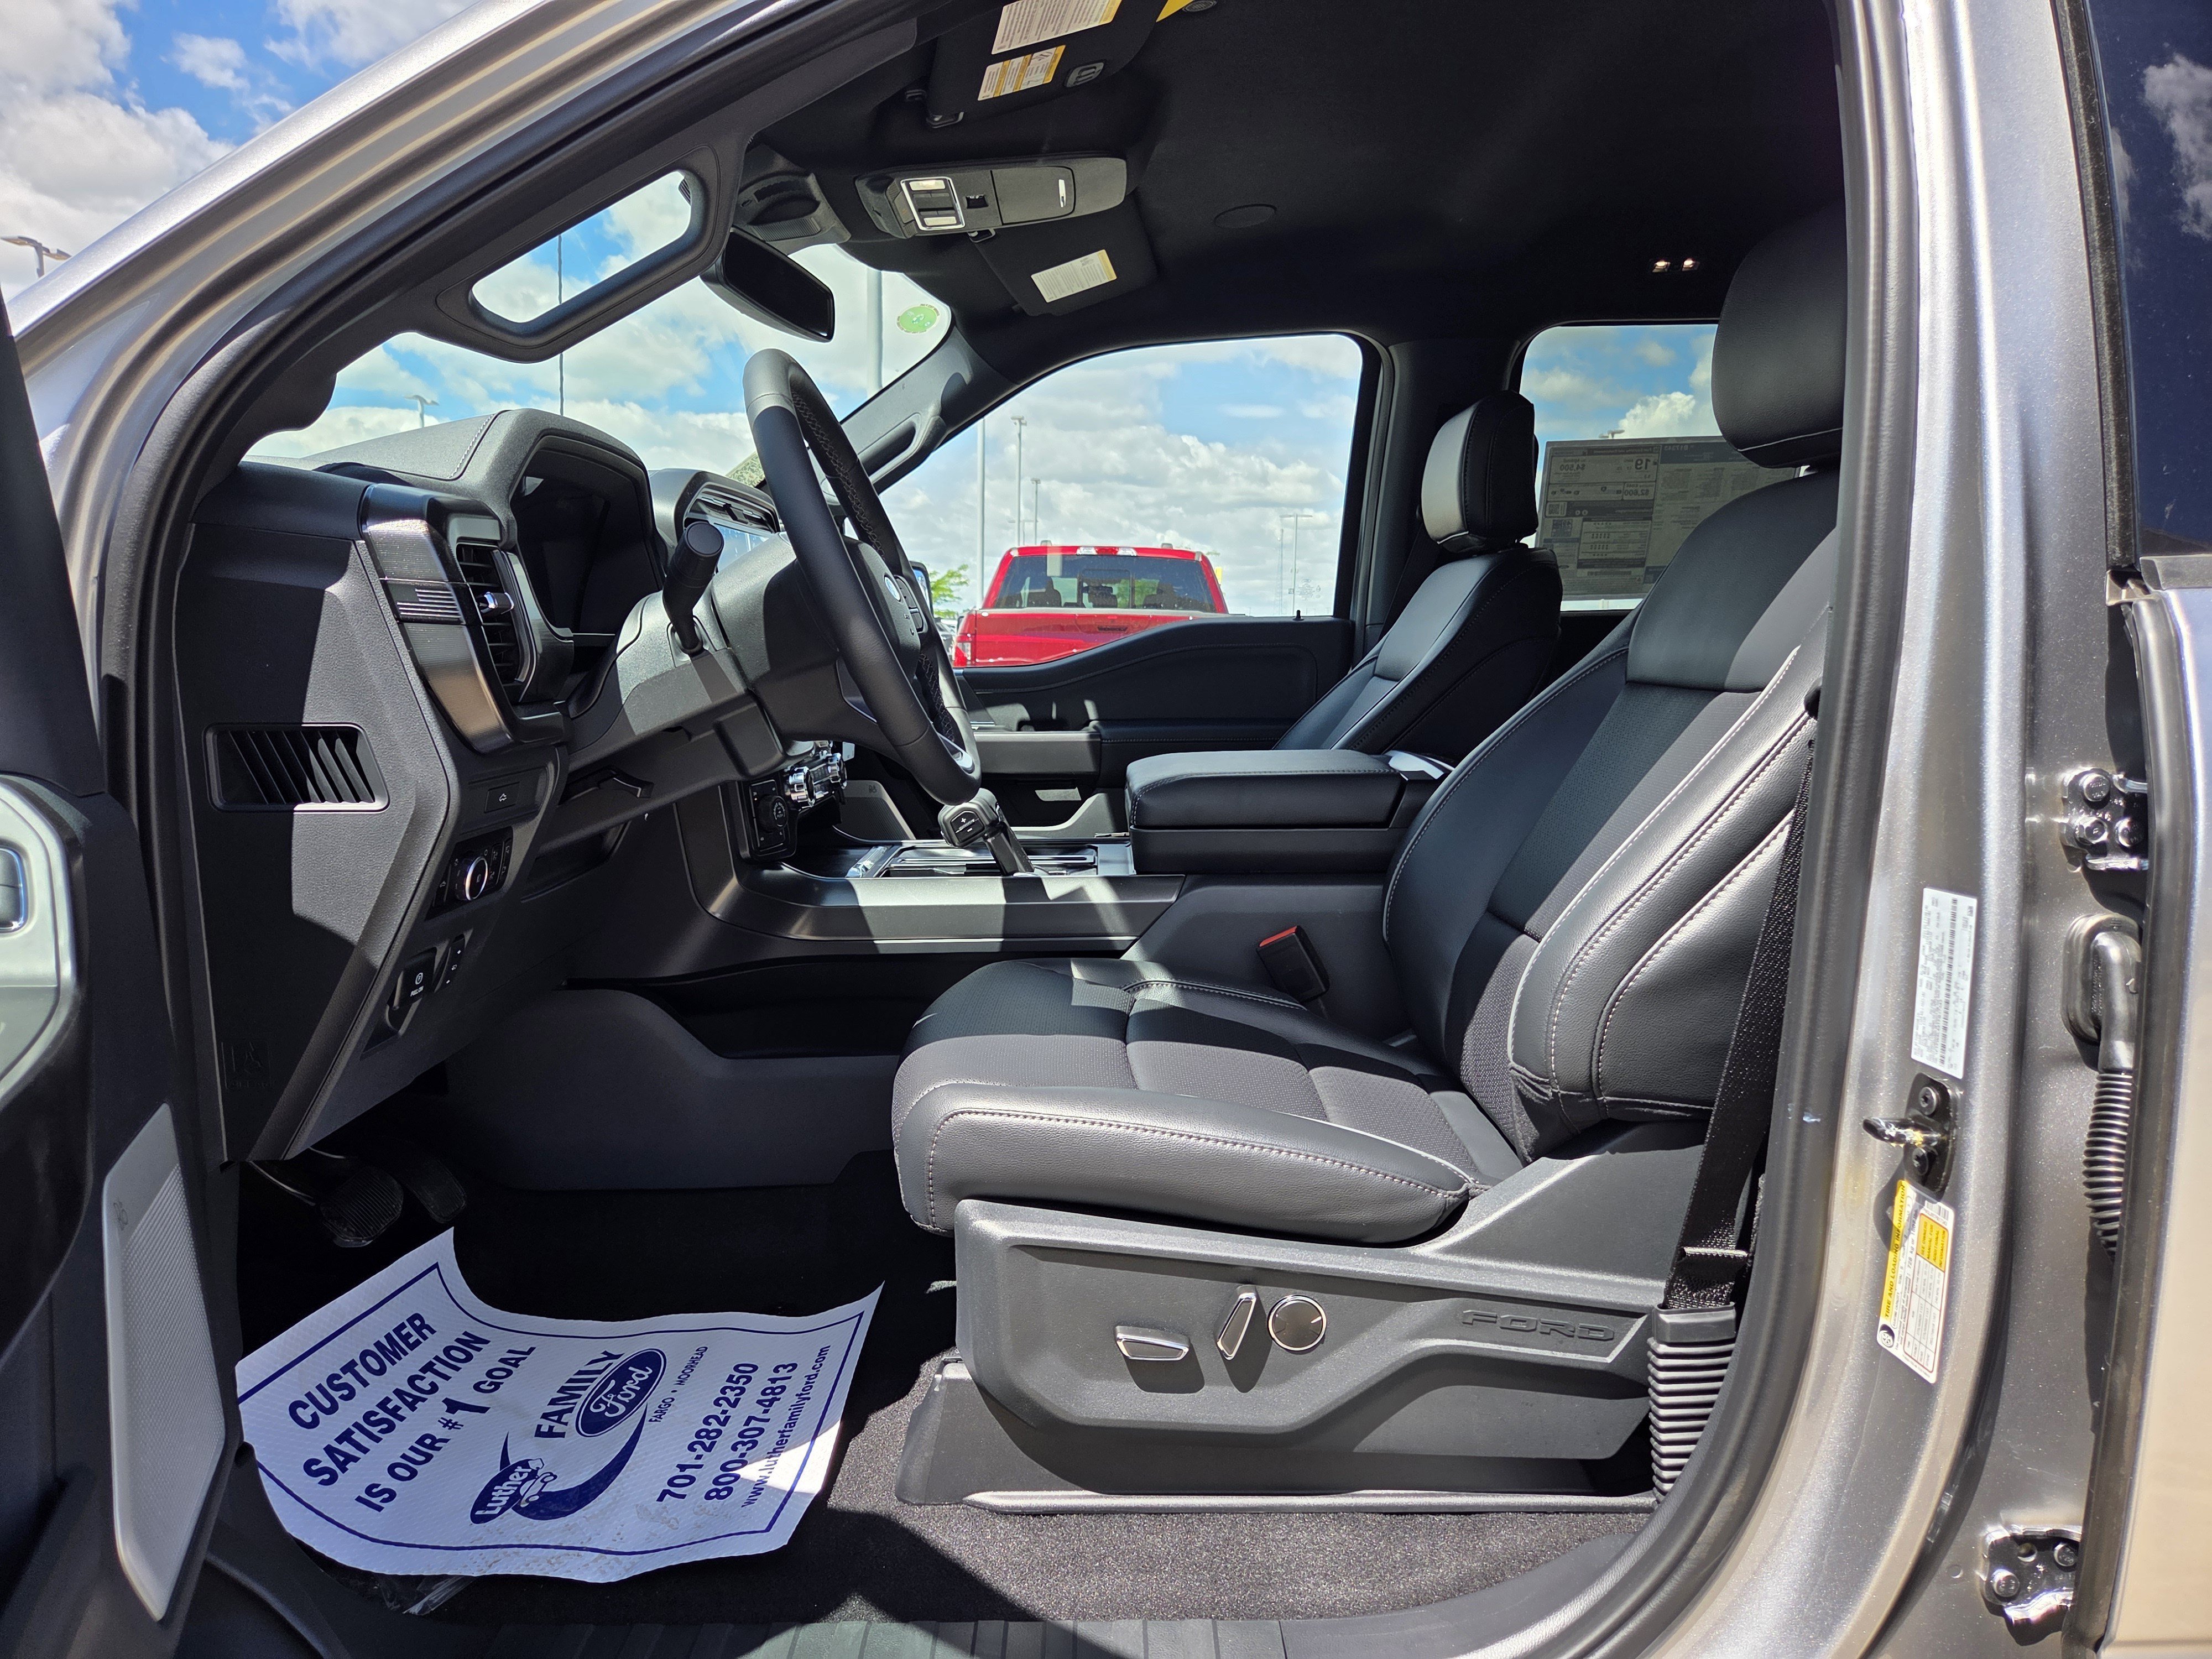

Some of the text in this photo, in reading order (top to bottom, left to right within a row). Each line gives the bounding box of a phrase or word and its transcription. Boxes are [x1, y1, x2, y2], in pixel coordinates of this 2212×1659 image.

[1890, 1244, 1899, 1279] LOADING
[1895, 1185, 1906, 1243] INFORMATION
[289, 1312, 437, 1430] CUSTOMER
[1462, 1309, 1614, 1341] FORD
[303, 1331, 492, 1486] SATISFACTION
[355, 1345, 536, 1512] IS OUR #1 GOAL
[534, 1350, 625, 1438] FAMILY
[589, 1366, 653, 1418] Ford
[649, 1345, 708, 1423] FARGO MOORHEAD
[656, 1363, 760, 1503] 701-282-2350
[704, 1363, 798, 1501] 800-307-4813
[742, 1345, 831, 1508] www.lutherfamilyford.com
[474, 1465, 532, 1516] Luther
